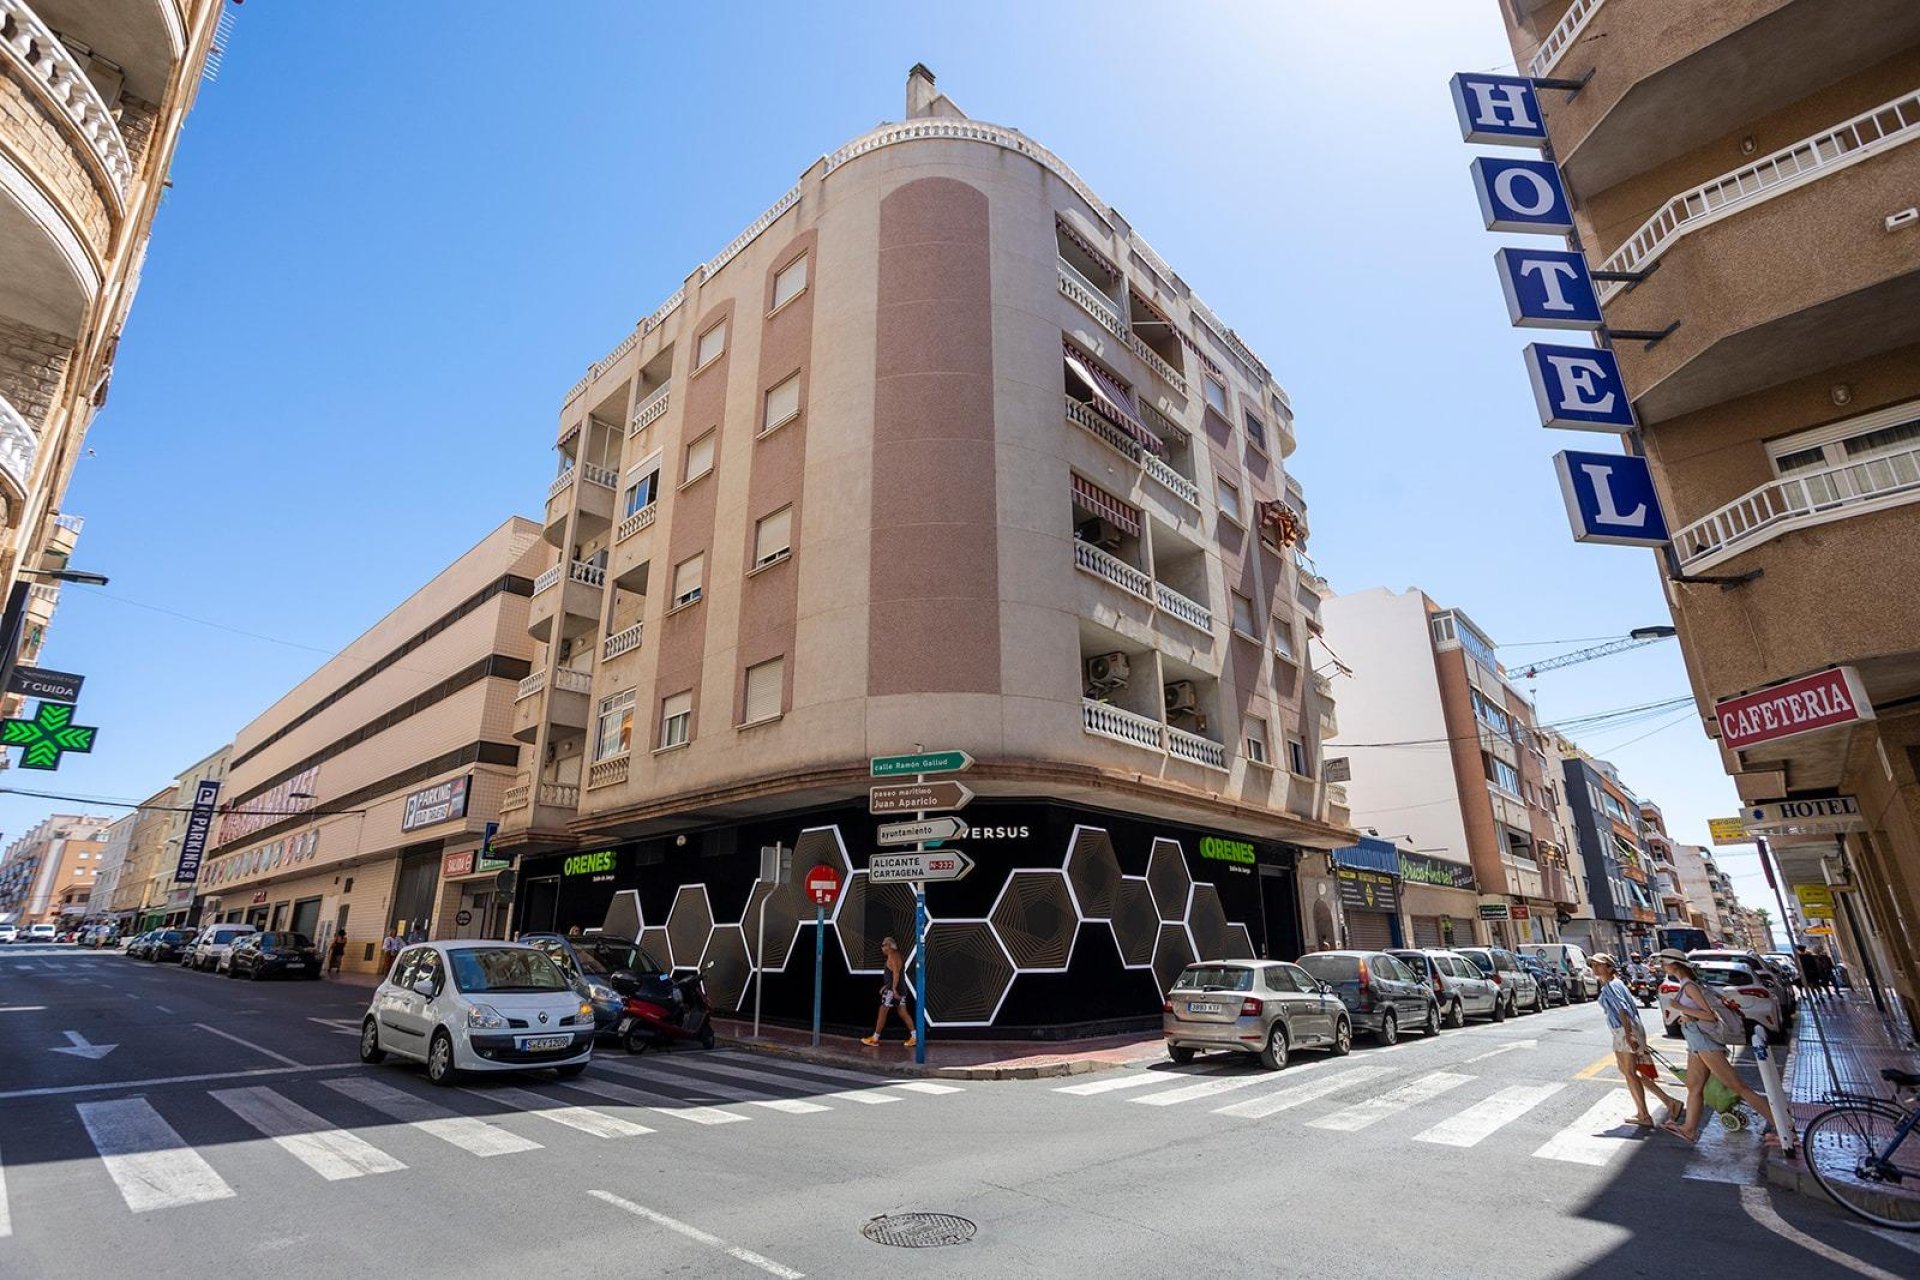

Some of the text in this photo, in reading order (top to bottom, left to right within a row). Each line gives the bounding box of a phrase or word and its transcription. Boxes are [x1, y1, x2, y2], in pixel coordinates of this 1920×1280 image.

[1466, 81, 1647, 527] HOTEL
[32, 683, 74, 696] CUIDA
[1723, 682, 1851, 740] CAFETERIA
[874, 763, 894, 772] calle
[922, 759, 948, 768] Gallud
[417, 783, 452, 808] PARKING
[873, 790, 897, 799] paseo
[873, 796, 938, 809] Juan Aparicio
[1779, 798, 1857, 818] HOTEL
[881, 826, 932, 838] ayuntamiento
[1203, 836, 1256, 865] ORENES
[563, 851, 613, 877] ORENES
[873, 857, 921, 868] ALICANTE
[929, 860, 955, 870] N-332
[873, 868, 925, 879] CARTAGENA
